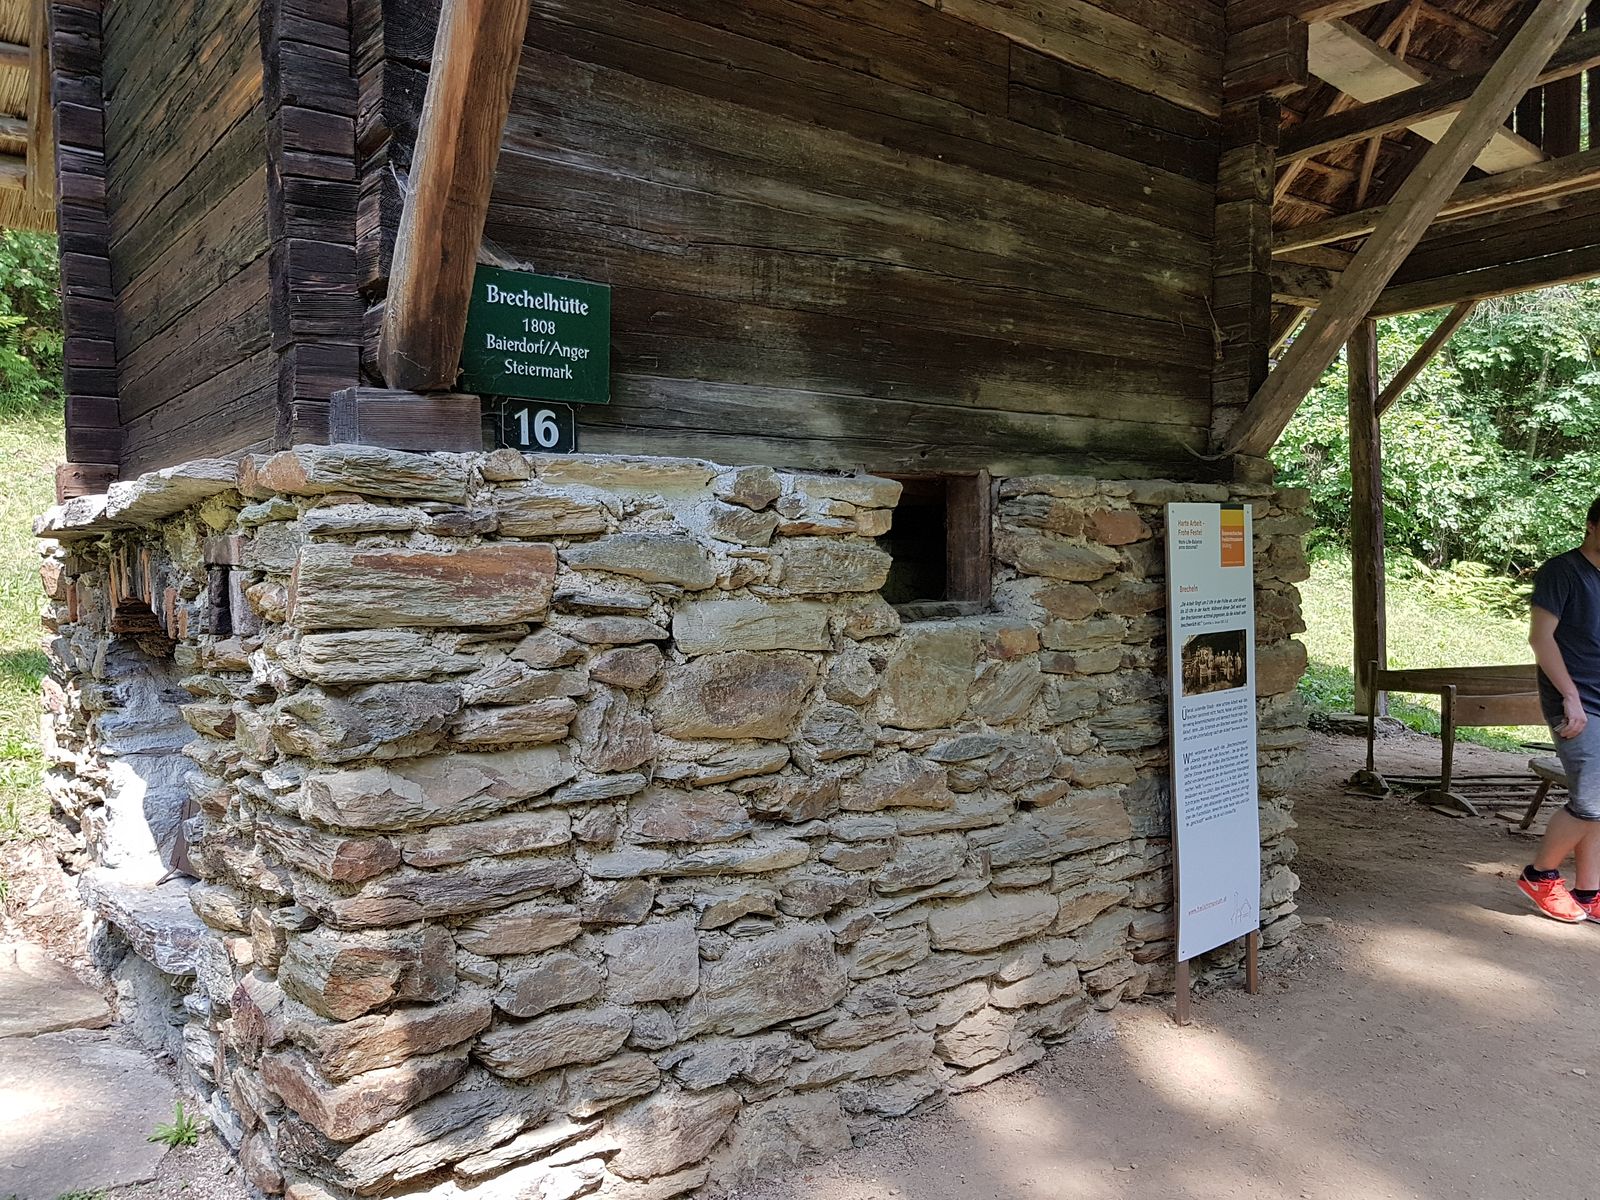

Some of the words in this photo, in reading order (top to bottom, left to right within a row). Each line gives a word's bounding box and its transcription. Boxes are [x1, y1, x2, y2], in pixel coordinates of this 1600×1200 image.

[486, 284, 589, 316] Brechelhütte
[522, 318, 556, 335] 1808
[486, 334, 590, 361] Baierdorf/Anger
[504, 359, 573, 380] Steiermark
[514, 407, 560, 448] 16
